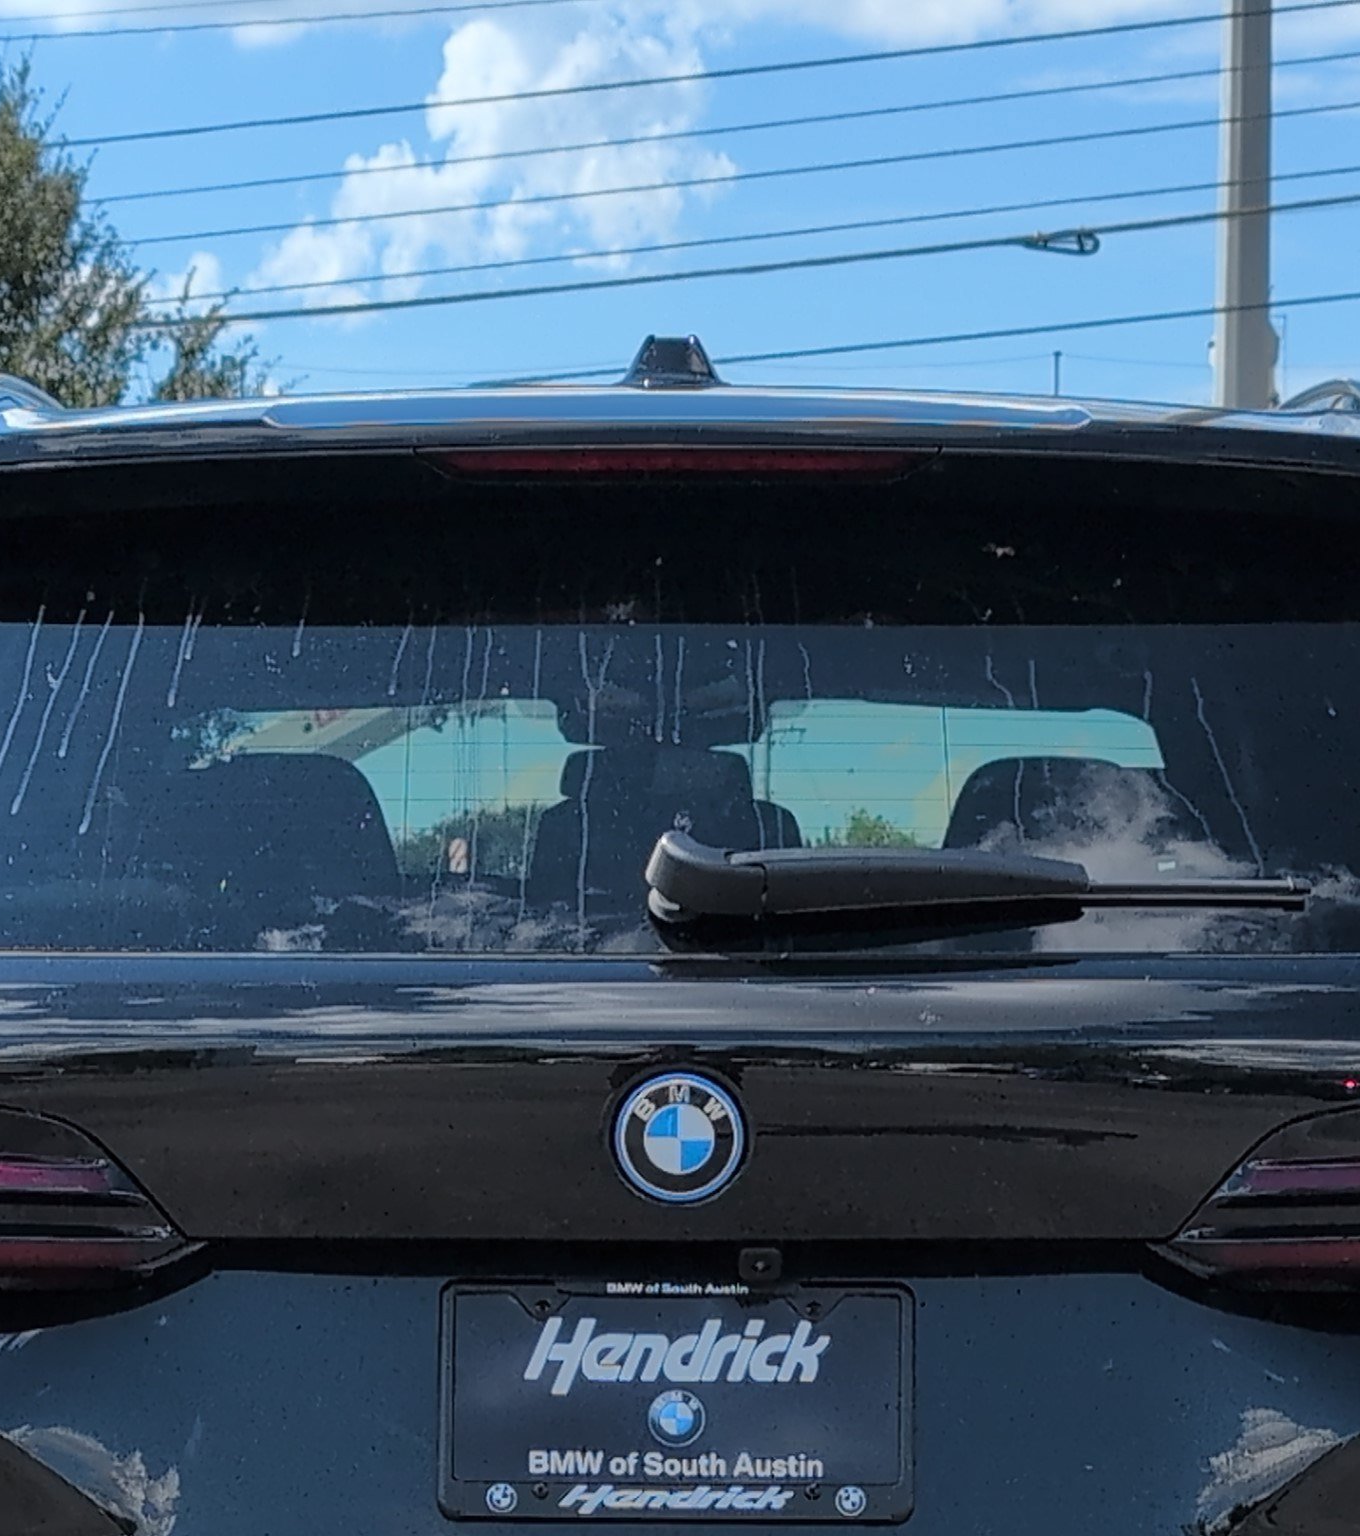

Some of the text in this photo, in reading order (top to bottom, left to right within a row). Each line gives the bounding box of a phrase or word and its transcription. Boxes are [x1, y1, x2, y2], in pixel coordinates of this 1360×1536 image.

[632, 1085, 726, 1121] BMW
[606, 1282, 749, 1295] BMW of South Austin
[523, 1316, 831, 1396] Hendrick
[529, 1450, 824, 1478] BMW of South Austin
[558, 1485, 794, 1514] Hendrick
